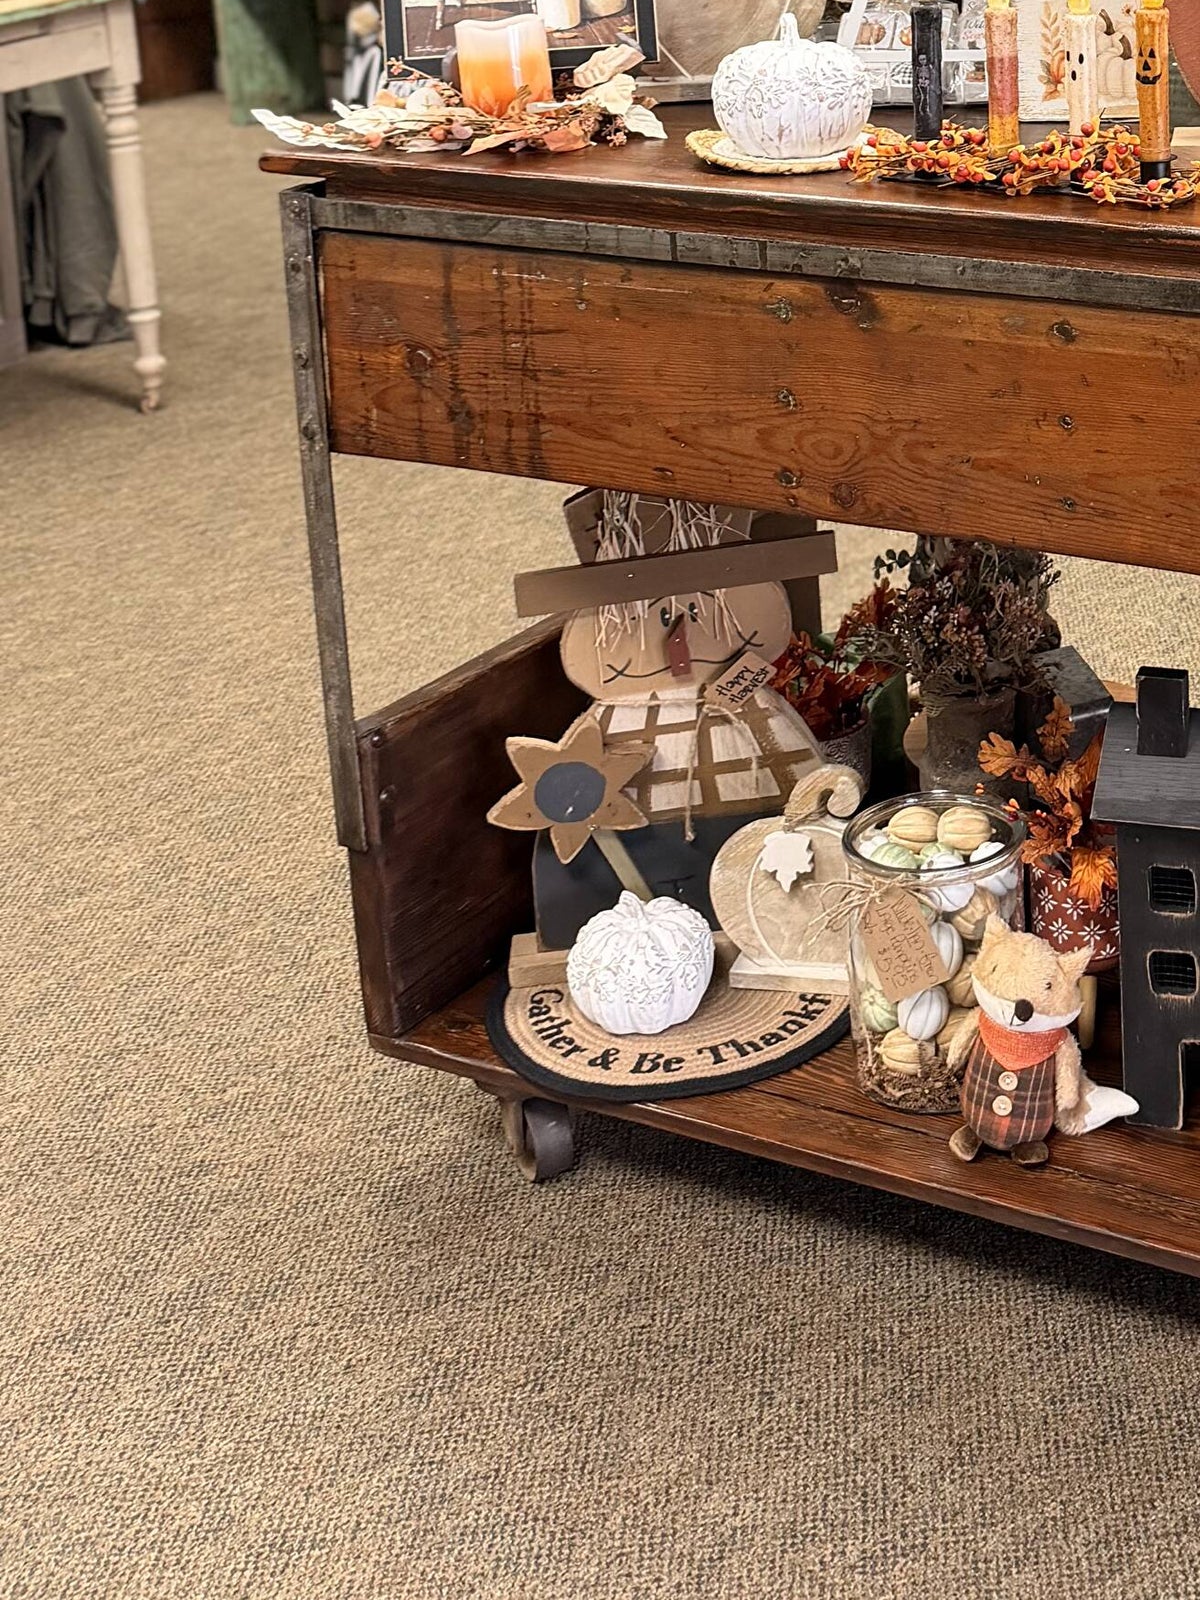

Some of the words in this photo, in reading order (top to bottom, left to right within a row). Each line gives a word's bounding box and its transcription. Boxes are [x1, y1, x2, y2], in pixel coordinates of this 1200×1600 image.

[529, 989, 588, 1052] Gather
[588, 1045, 621, 1071] &
[630, 1051, 686, 1075] Be
[700, 993, 832, 1065] Thankf
